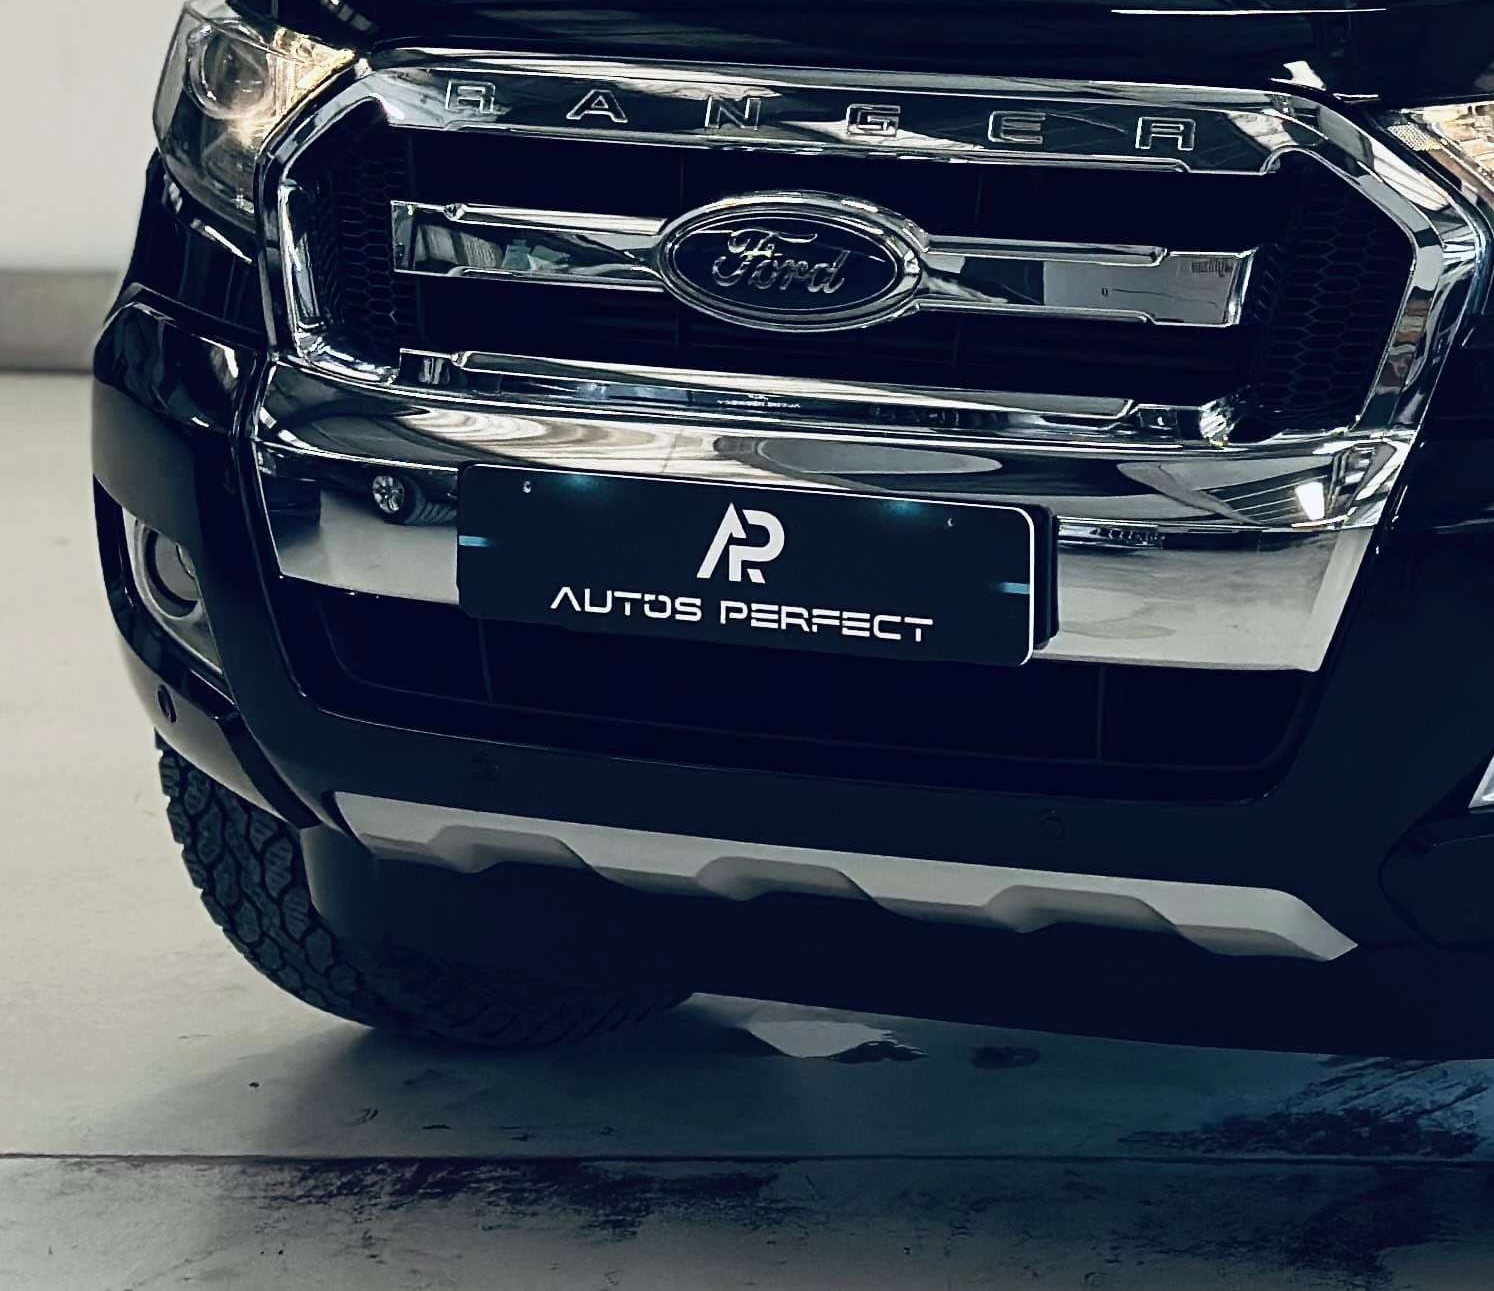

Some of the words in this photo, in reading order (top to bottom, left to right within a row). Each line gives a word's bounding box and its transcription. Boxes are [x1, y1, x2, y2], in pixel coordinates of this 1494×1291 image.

[444, 78, 1197, 152] RANGER
[712, 228, 850, 294] Ford
[550, 586, 702, 622] AUTOS
[720, 600, 934, 643] PERFECT
